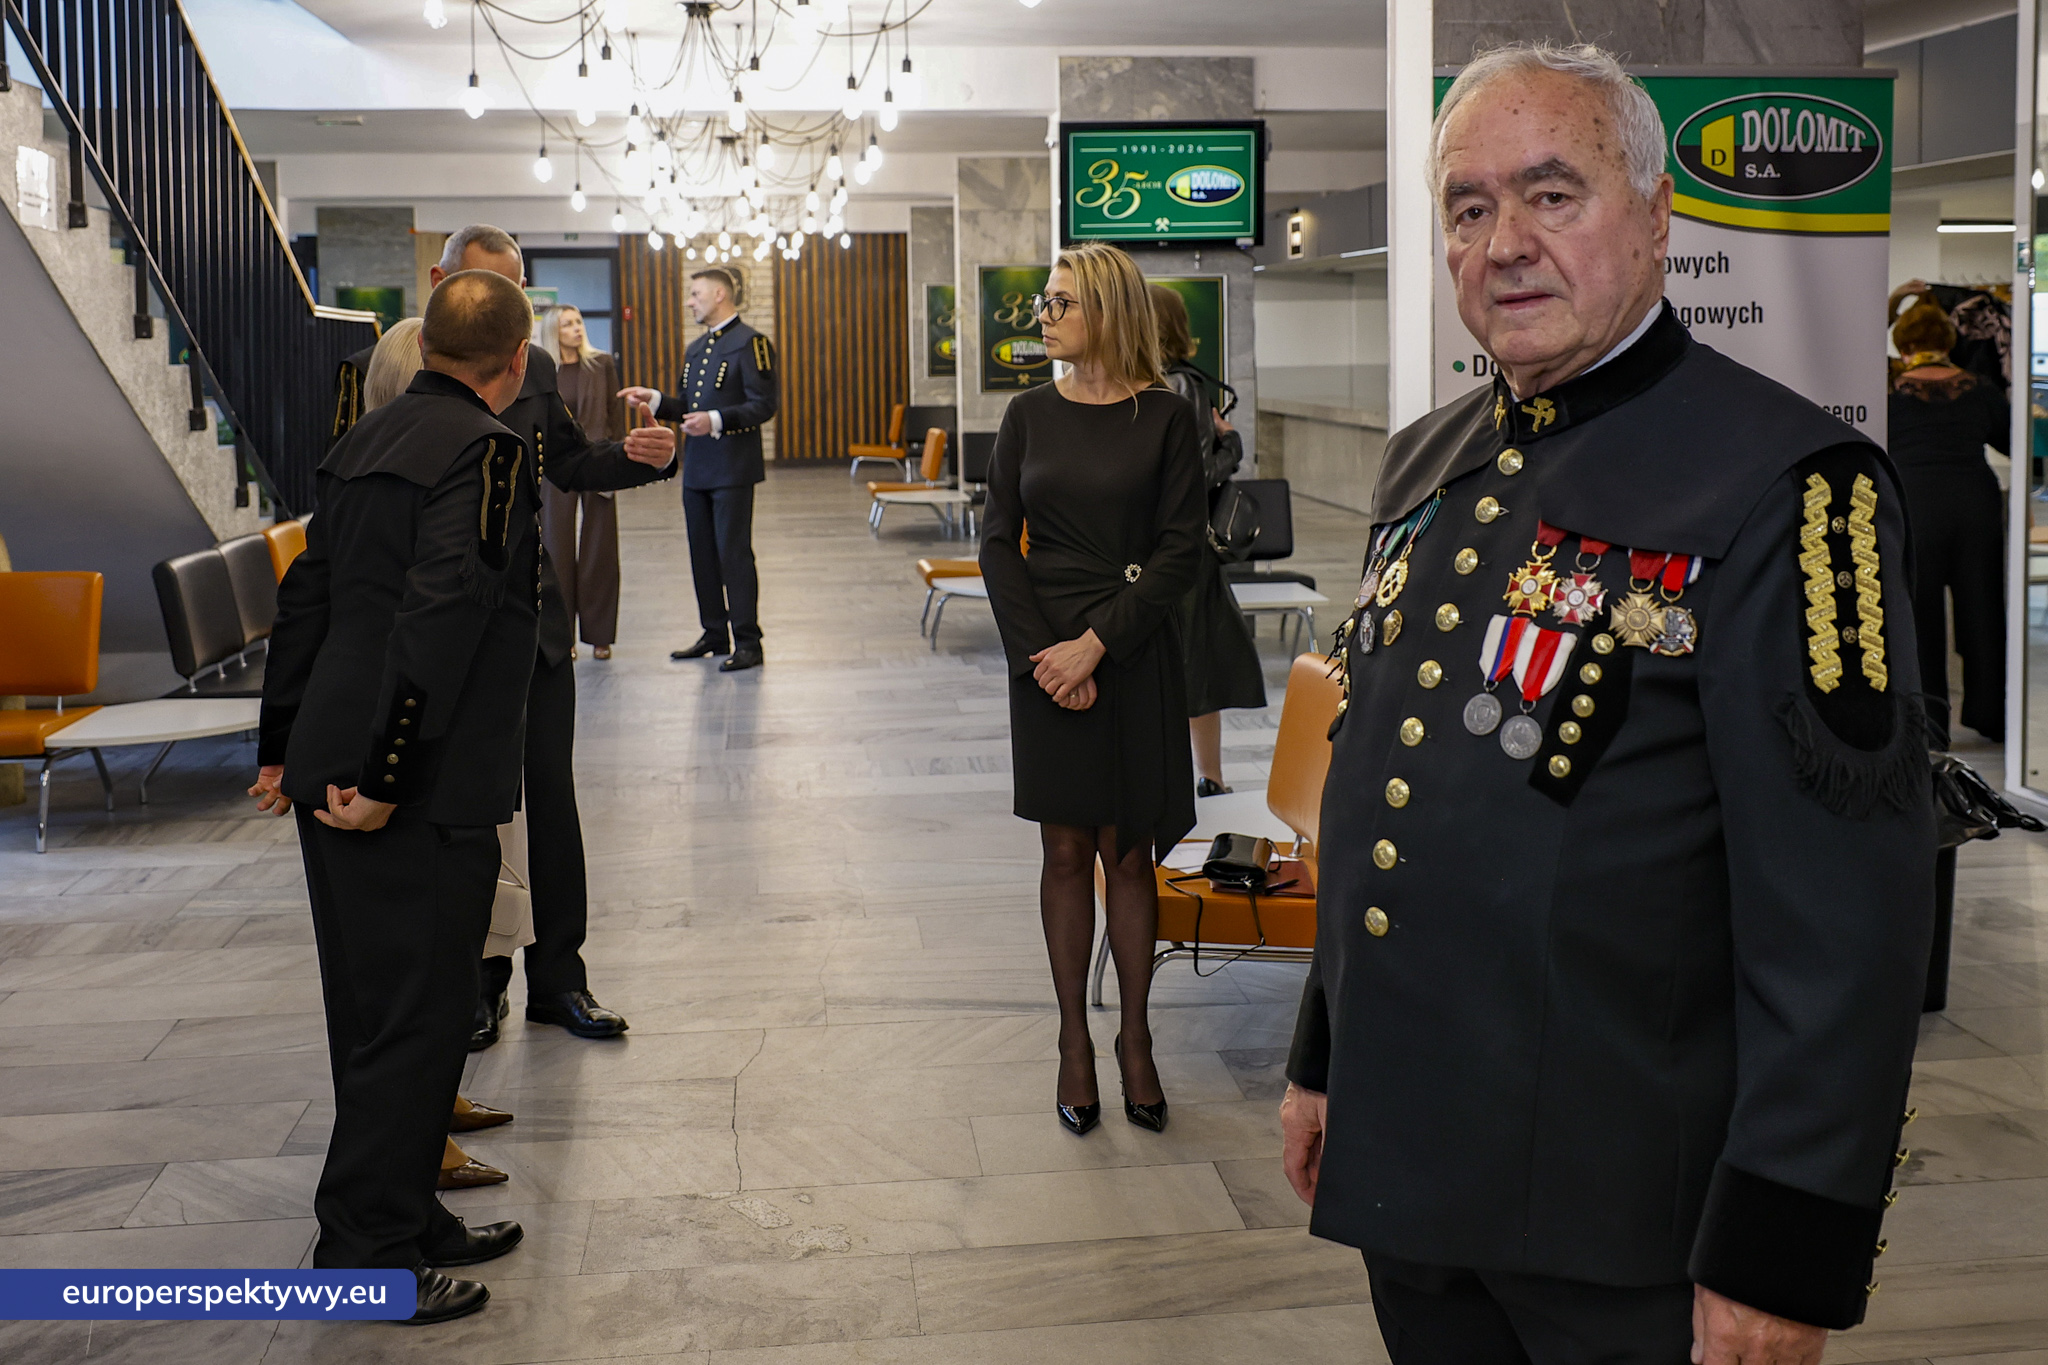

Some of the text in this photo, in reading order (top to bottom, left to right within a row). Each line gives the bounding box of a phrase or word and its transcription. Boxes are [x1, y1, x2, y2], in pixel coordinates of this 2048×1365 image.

[1741, 106, 1867, 153] DOLOMIT
[1122, 143, 1204, 155] 1991-2026
[1711, 149, 1727, 166] D
[1744, 163, 1781, 179] S.A.
[1075, 158, 1149, 220] 35
